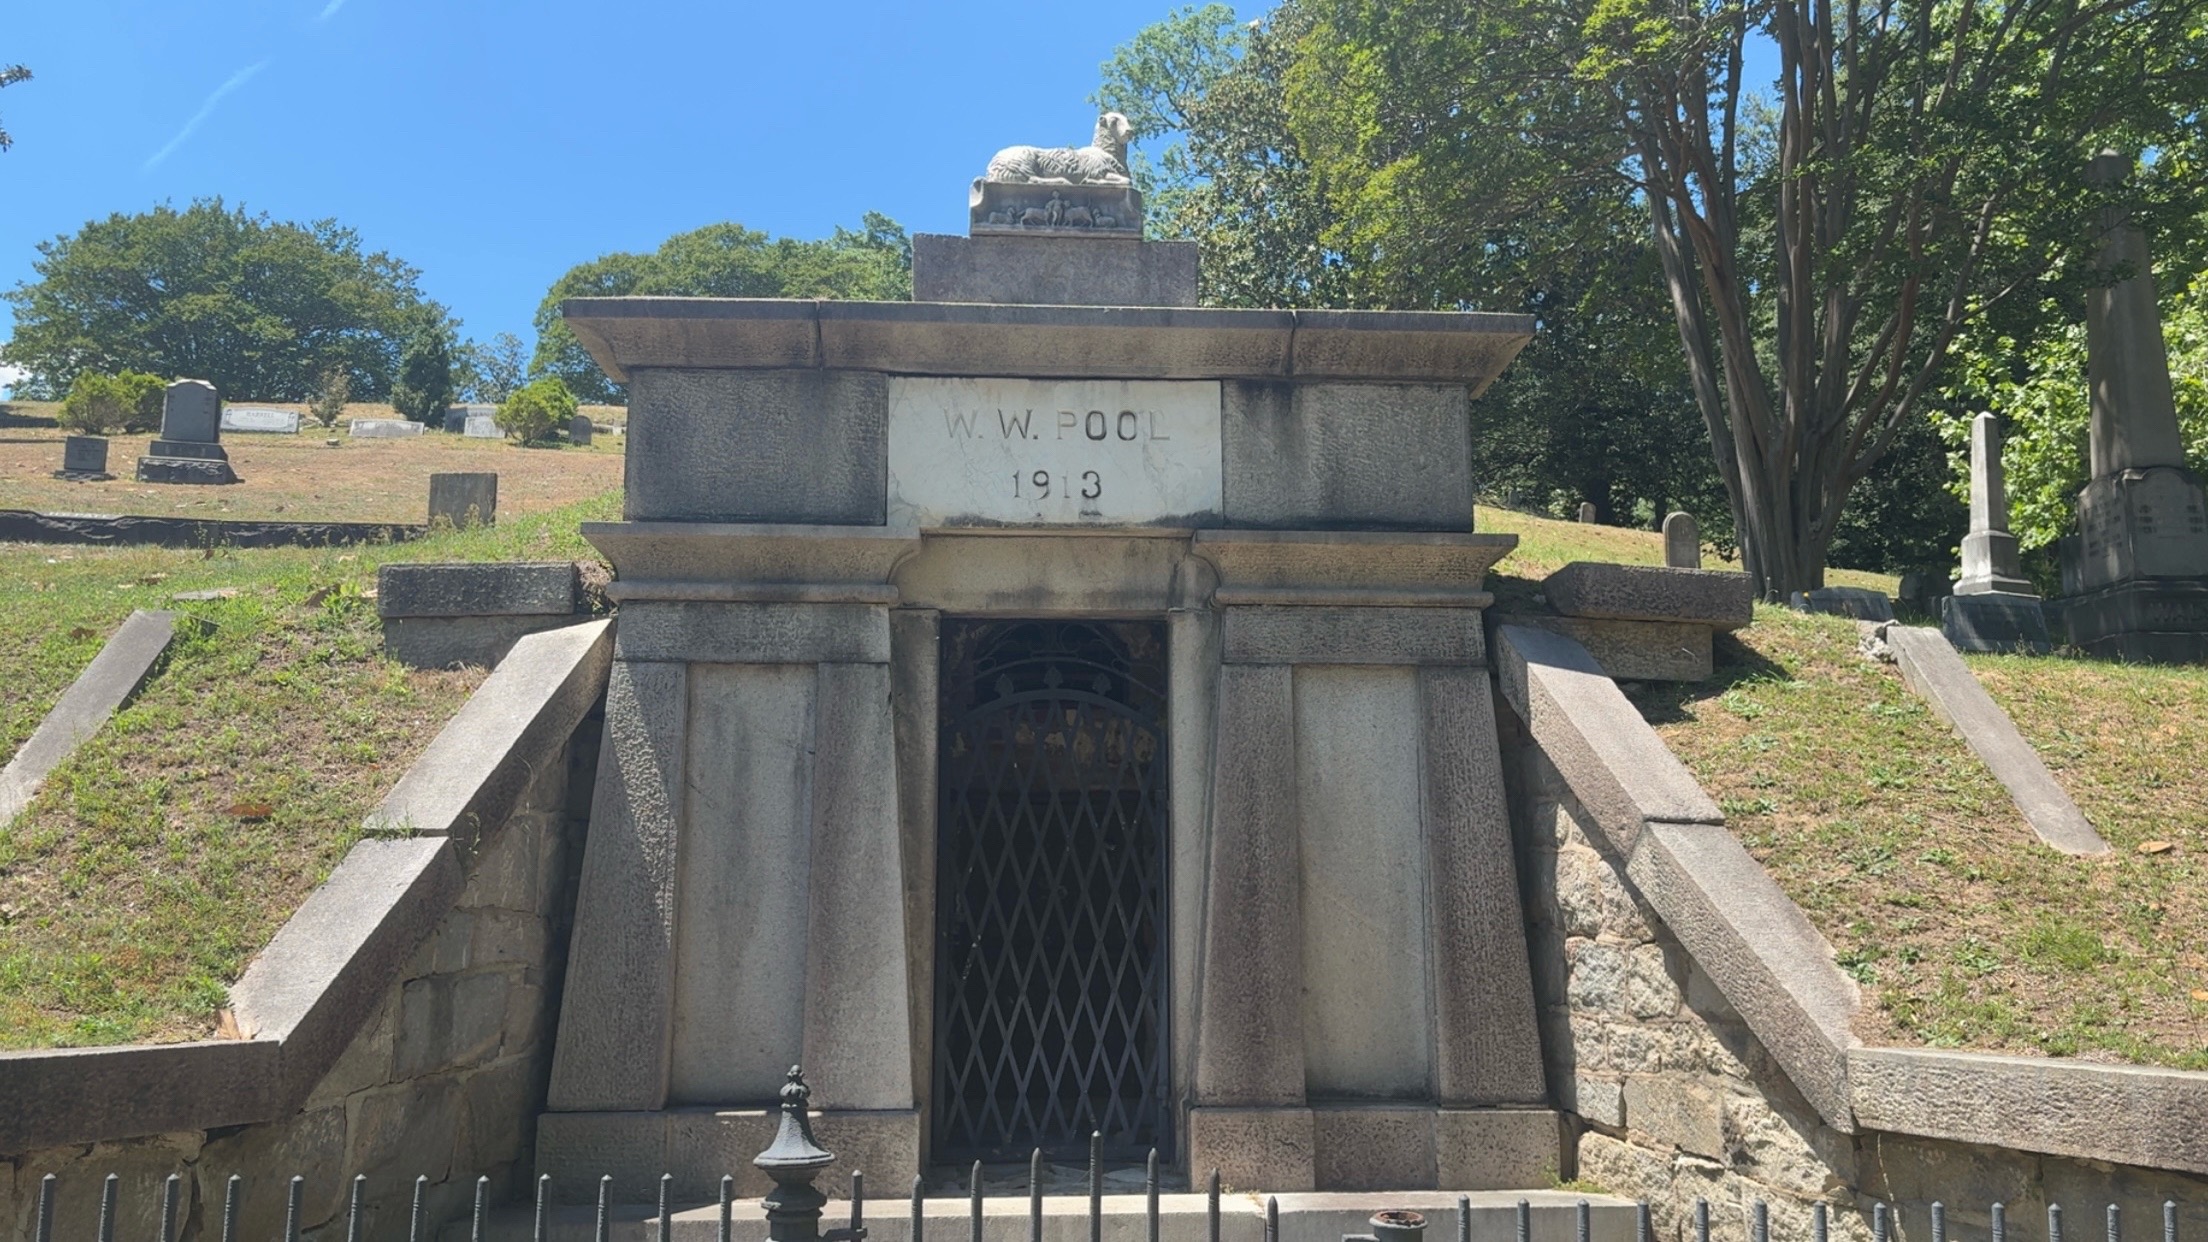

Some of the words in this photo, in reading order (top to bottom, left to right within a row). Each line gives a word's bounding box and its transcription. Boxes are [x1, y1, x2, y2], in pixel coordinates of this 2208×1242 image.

[943, 408, 984, 440] W.
[997, 408, 1038, 441] W.
[1055, 409, 1170, 442] POOL
[1012, 470, 1102, 500] 1913
